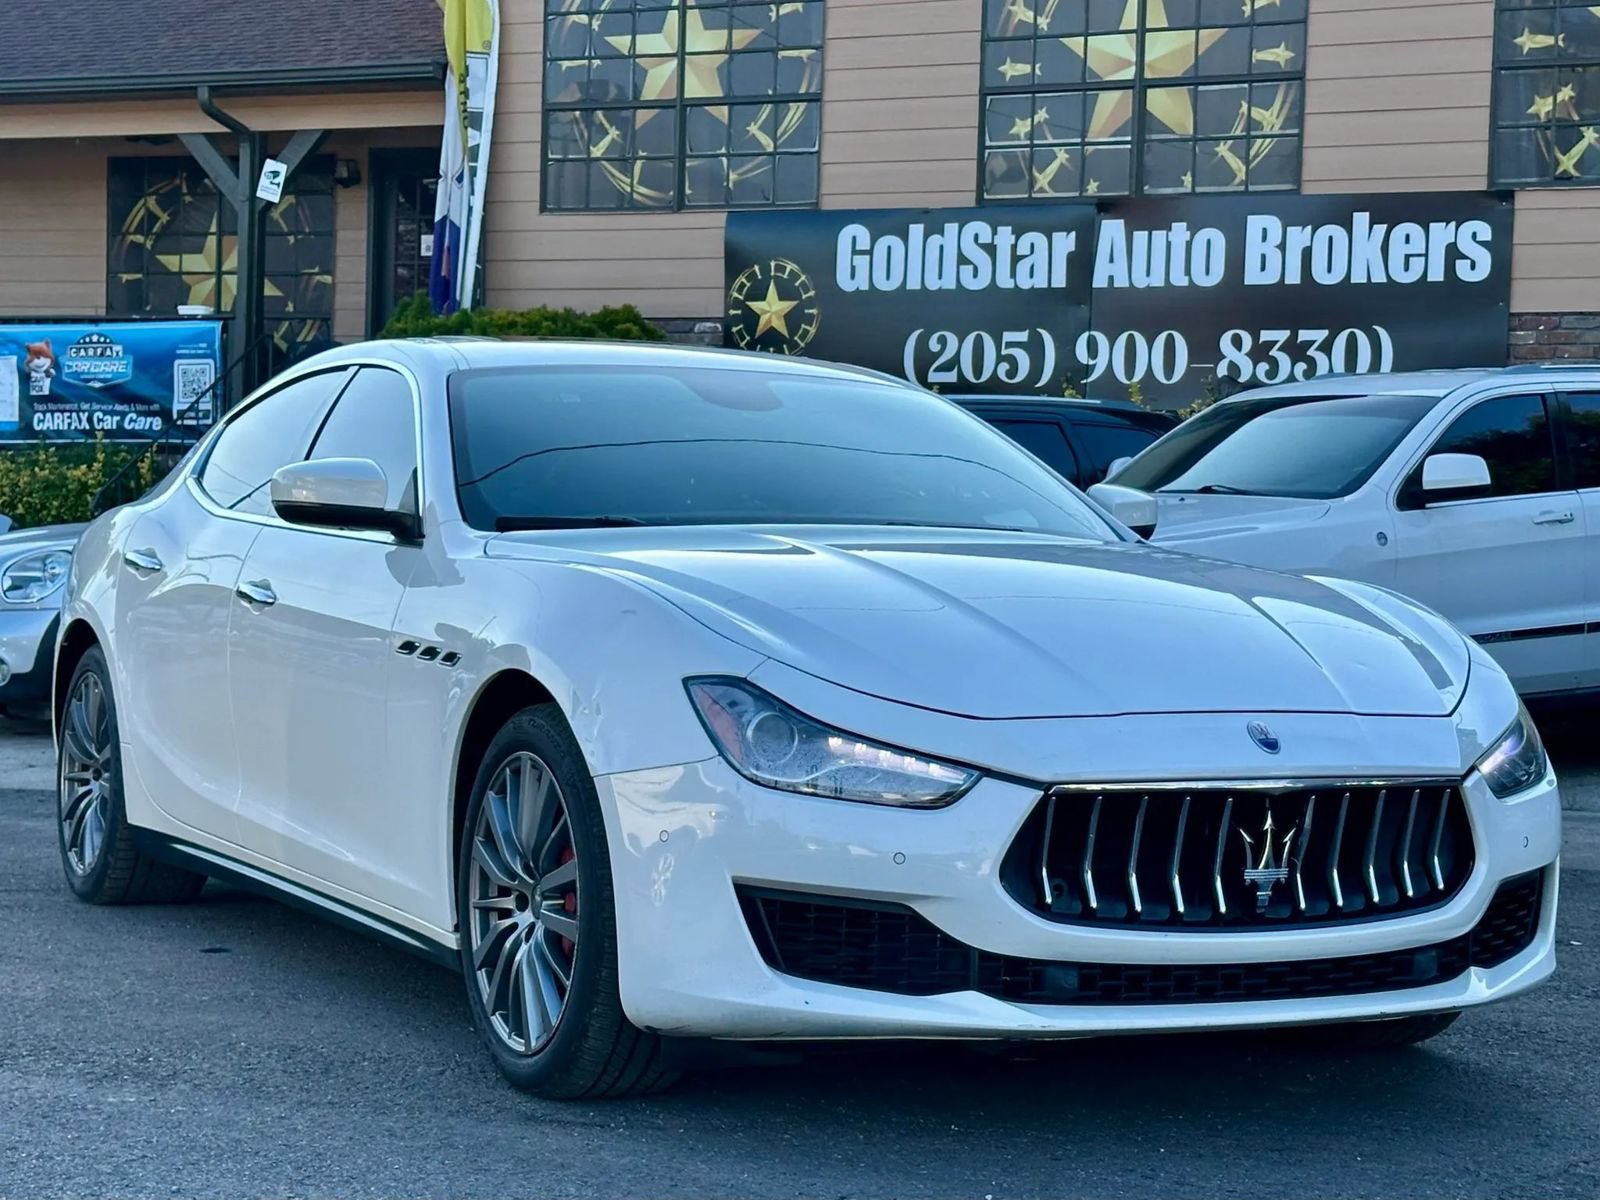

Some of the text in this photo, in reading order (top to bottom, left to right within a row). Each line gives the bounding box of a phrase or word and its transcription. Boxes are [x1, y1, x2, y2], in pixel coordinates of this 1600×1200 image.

[836, 211, 1492, 292] GoldStar Auto Brokers
[70, 347, 122, 357] CARFAX
[903, 328, 1056, 389] (205)
[33, 411, 90, 430] CARFAX
[93, 411, 120, 430] Car
[123, 412, 162, 431] Care
